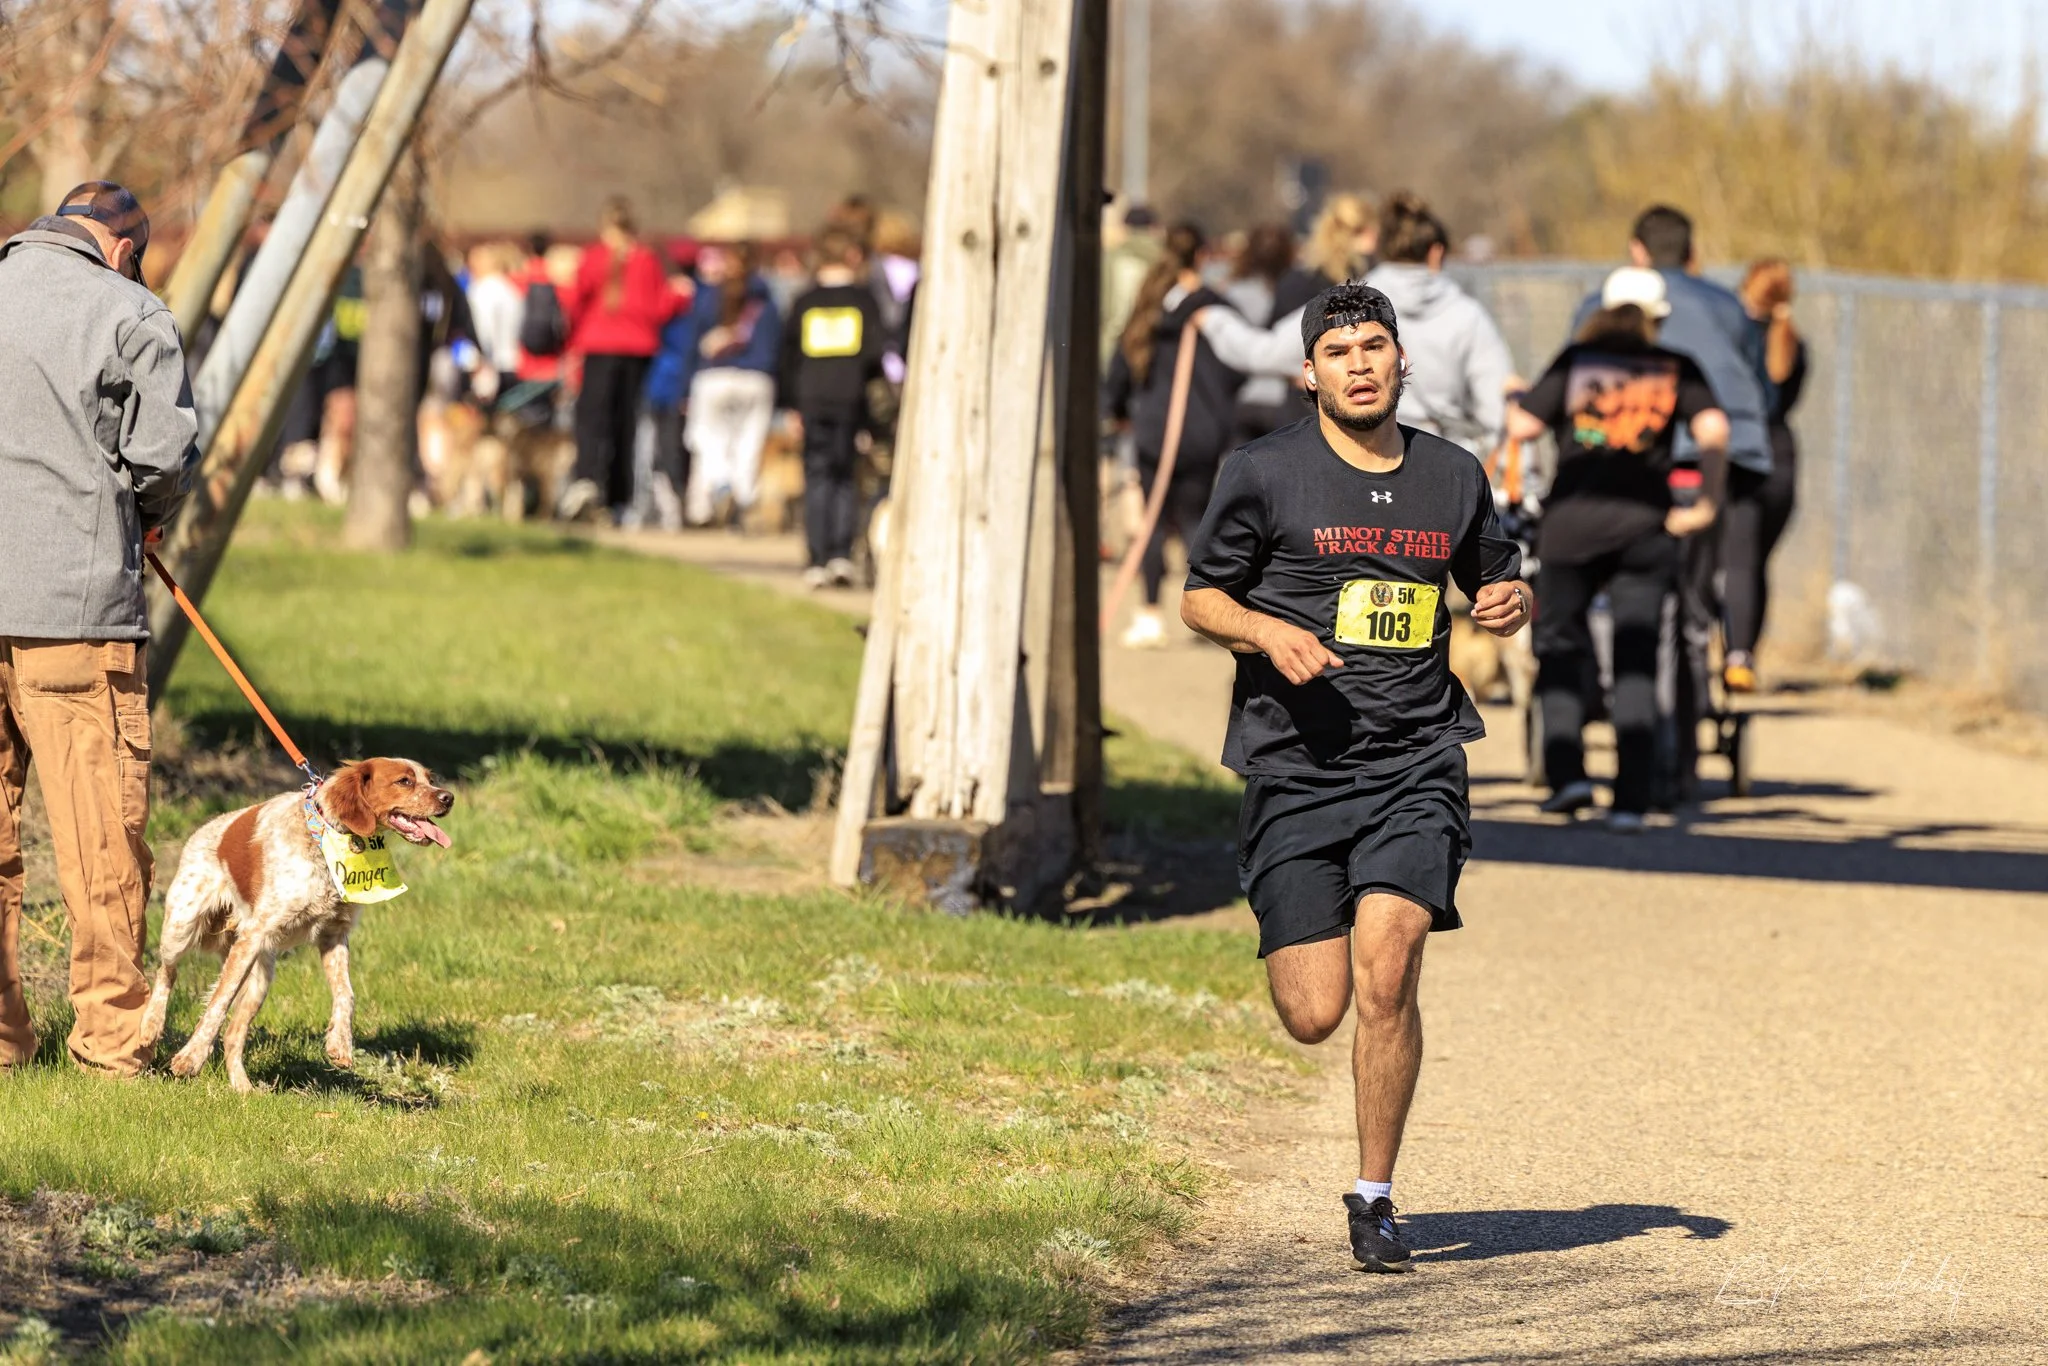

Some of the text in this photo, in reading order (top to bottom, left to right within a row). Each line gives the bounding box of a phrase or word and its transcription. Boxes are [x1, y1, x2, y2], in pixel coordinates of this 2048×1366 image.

[1313, 526, 1451, 546] MINOT STATE
[1314, 540, 1451, 560] TRACK & FIELD
[1397, 587, 1417, 605] 5K
[1366, 610, 1412, 643] 103
[367, 834, 386, 850] 5K
[335, 860, 389, 892] Danger
